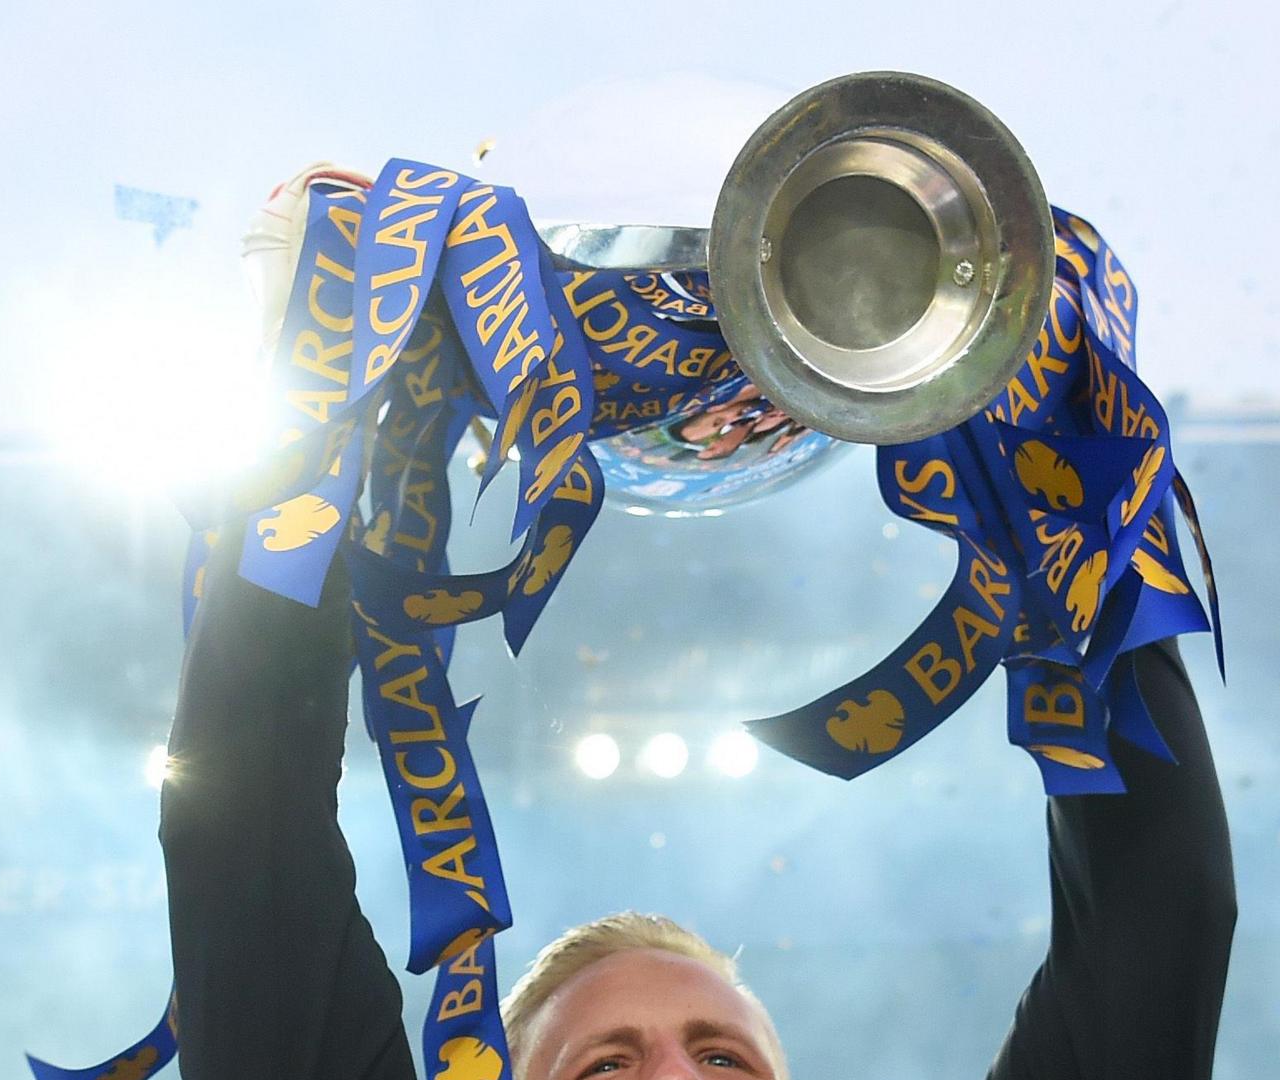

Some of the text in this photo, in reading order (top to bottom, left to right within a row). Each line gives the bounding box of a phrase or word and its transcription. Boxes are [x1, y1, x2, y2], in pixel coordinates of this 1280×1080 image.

[986, 284, 1083, 427] ARC
[360, 600, 491, 913] ARCLAY
[436, 938, 487, 1023] BA
